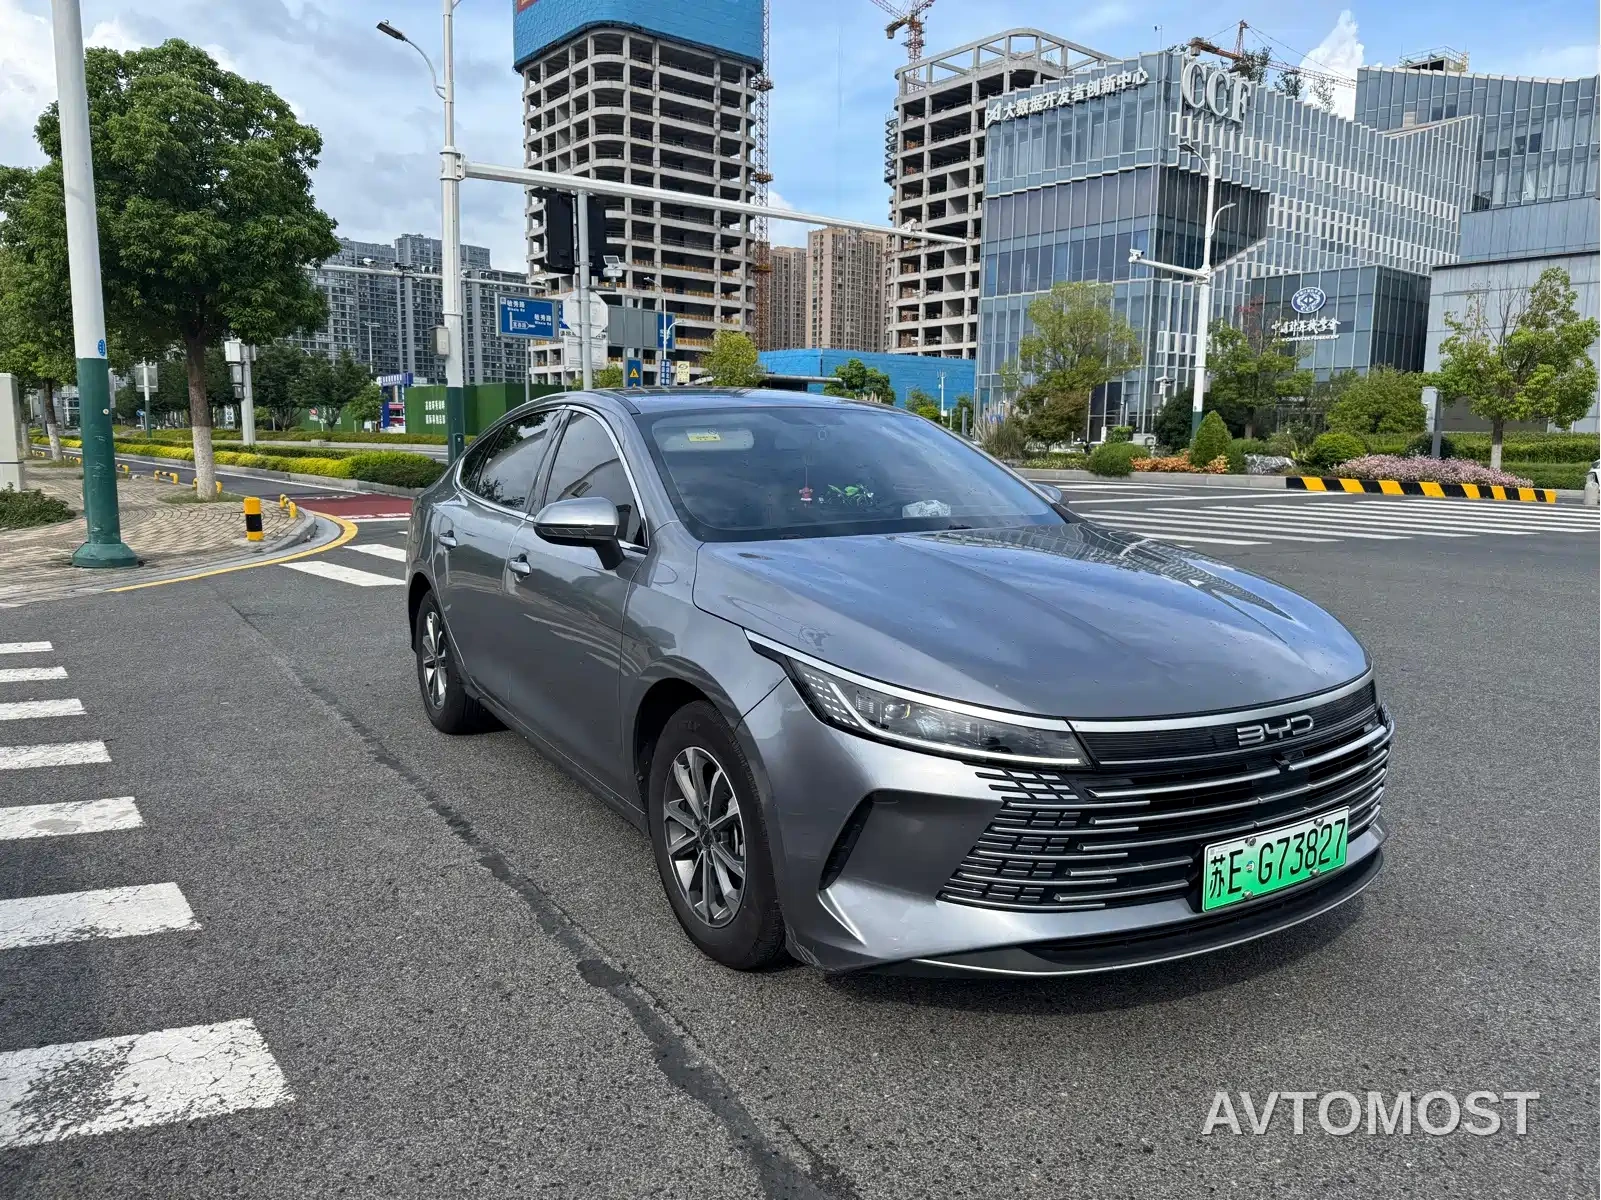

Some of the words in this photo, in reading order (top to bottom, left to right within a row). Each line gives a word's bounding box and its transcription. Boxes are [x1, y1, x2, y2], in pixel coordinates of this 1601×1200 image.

[1003, 66, 1149, 121] 大数据开发者创新中心
[1182, 60, 1250, 123] CCF
[1237, 714, 1314, 746] BYD
